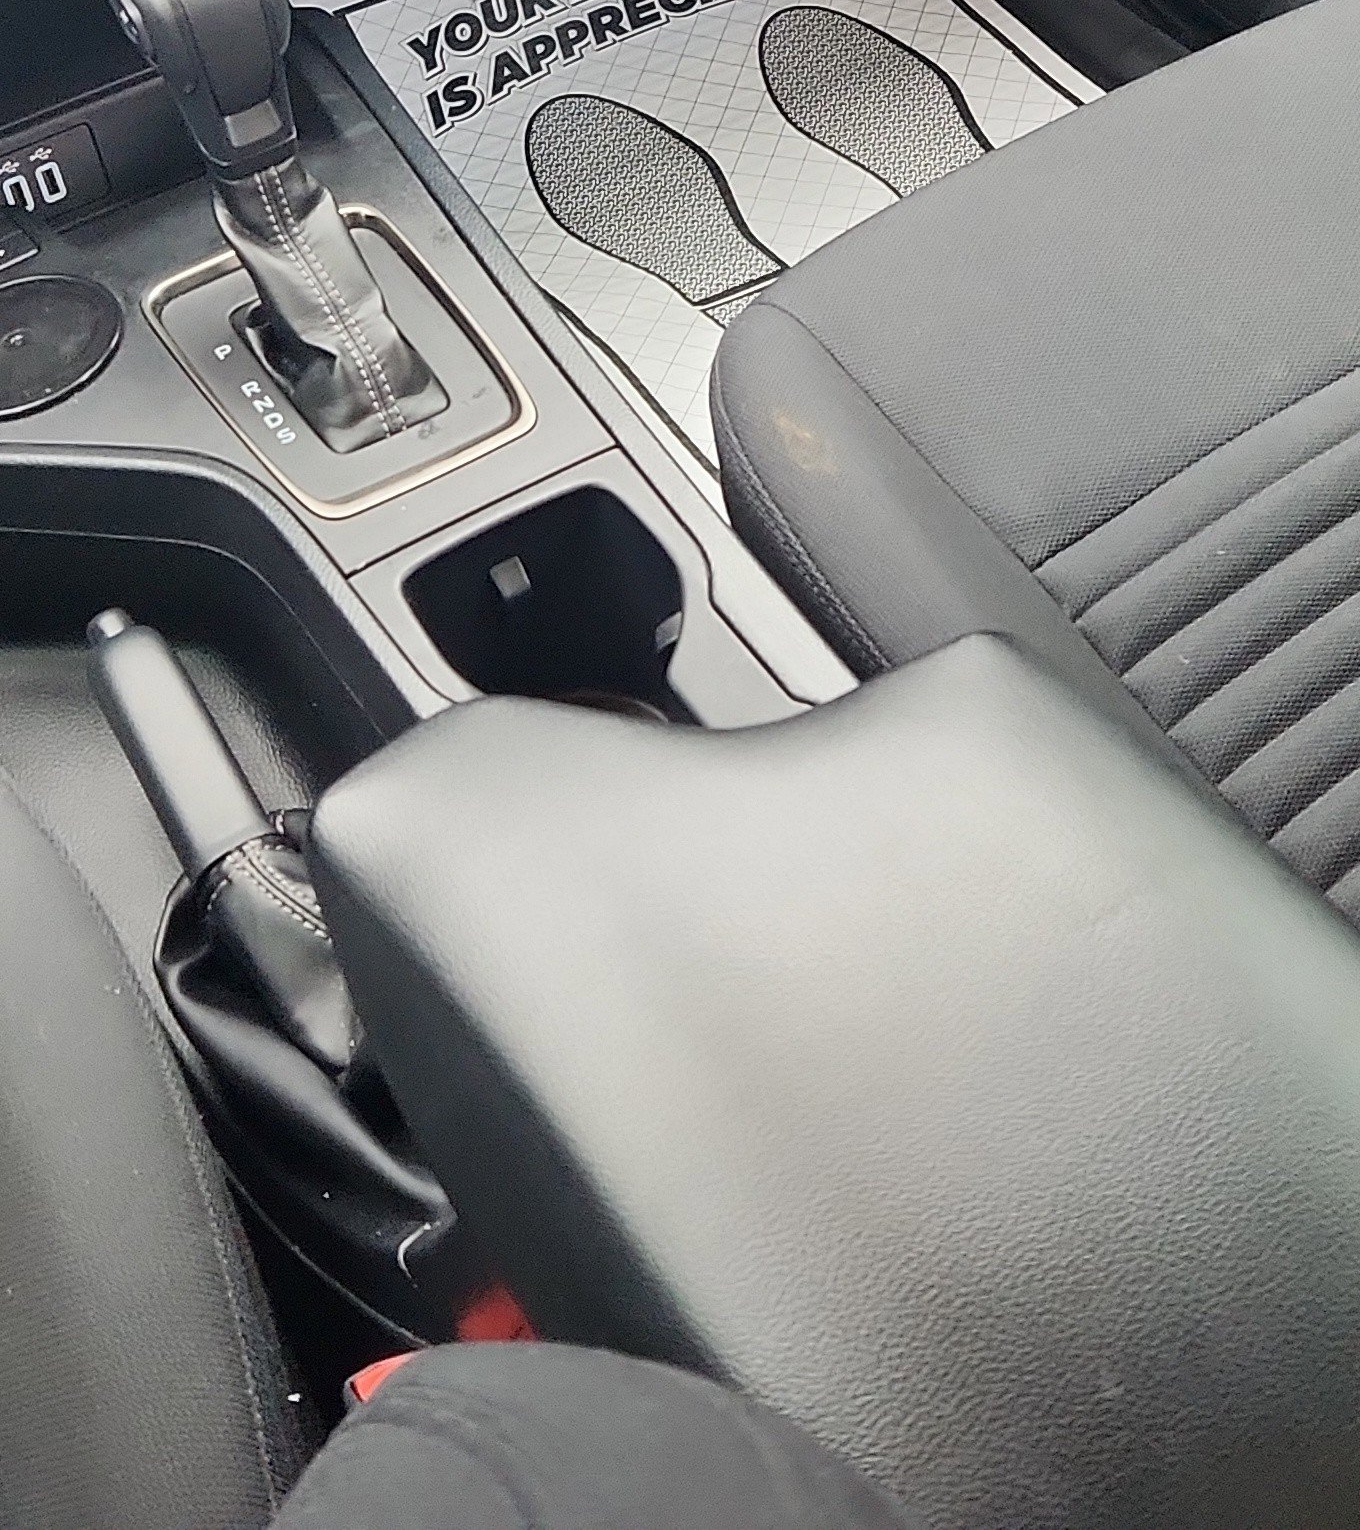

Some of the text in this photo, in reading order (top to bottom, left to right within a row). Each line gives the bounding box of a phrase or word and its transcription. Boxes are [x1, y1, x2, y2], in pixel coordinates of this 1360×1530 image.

[424, 73, 486, 138] IS
[213, 344, 232, 361] P
[240, 380, 262, 399] R
[252, 395, 275, 413] N
[263, 412, 284, 430] D
[276, 427, 296, 445] S
